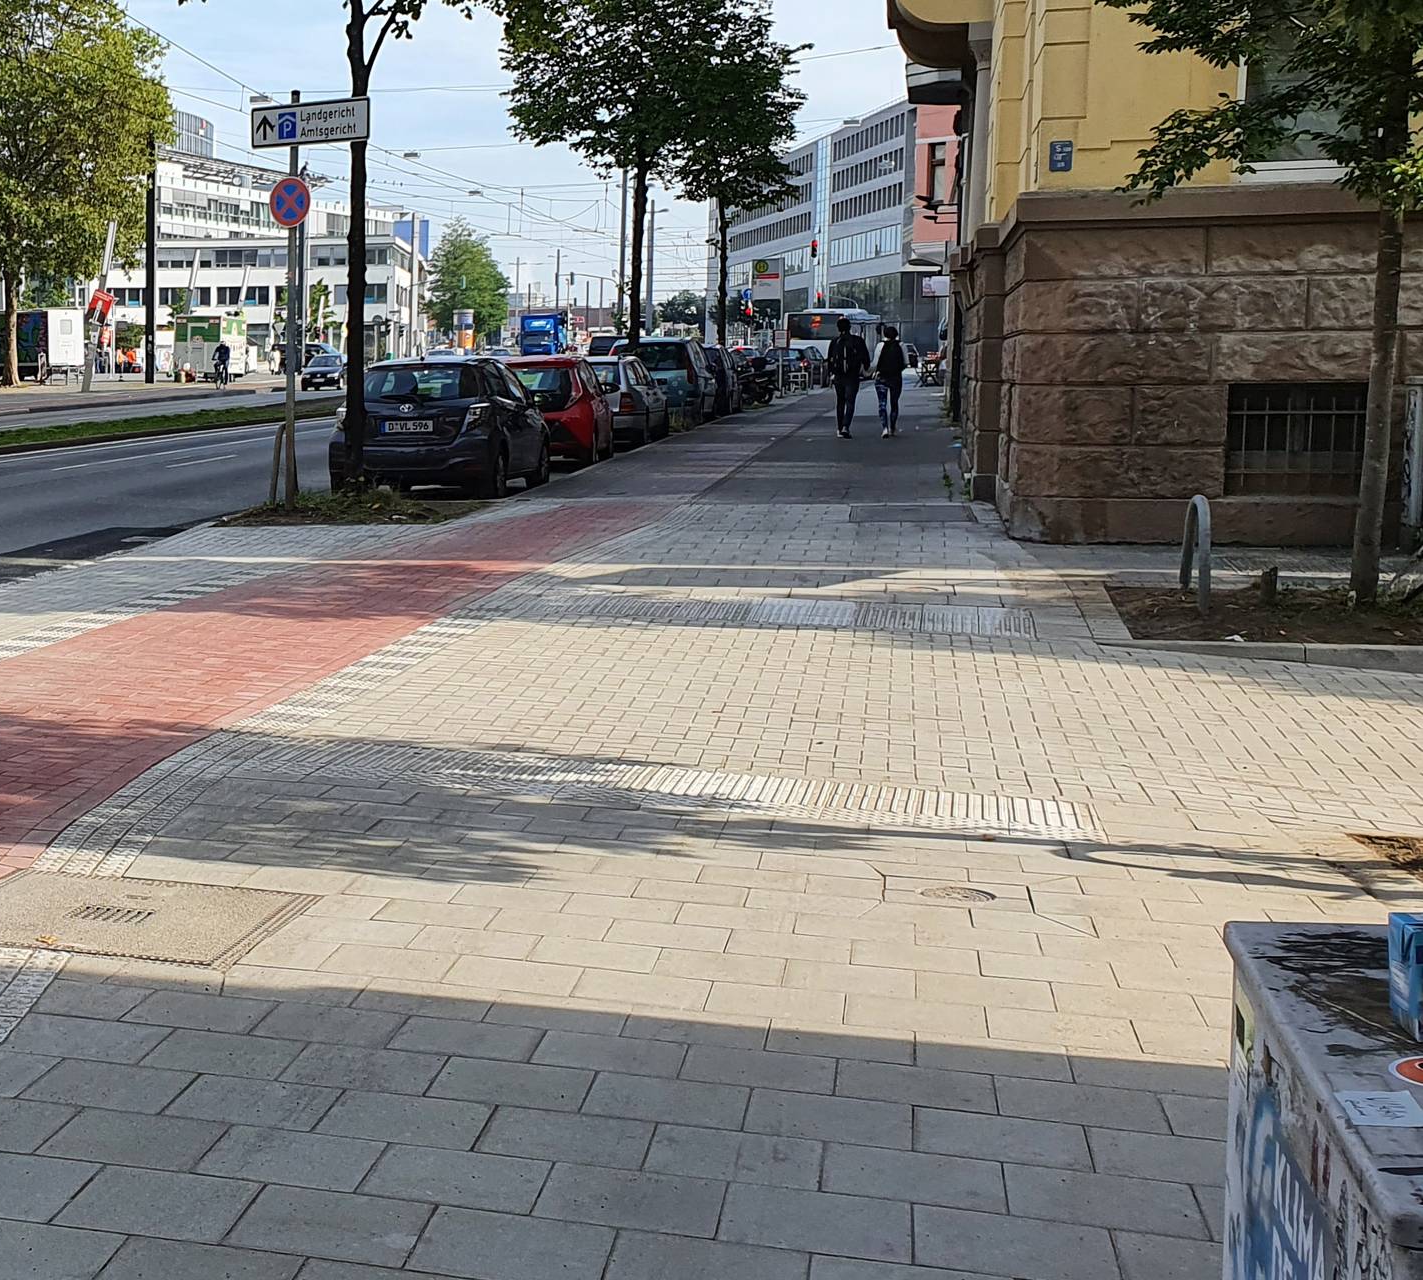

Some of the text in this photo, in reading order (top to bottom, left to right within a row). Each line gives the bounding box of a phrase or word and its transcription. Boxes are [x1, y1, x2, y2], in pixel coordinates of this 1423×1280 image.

[300, 106, 355, 121] Landgericht
[283, 120, 292, 138] P
[300, 123, 356, 138] Amtsgericht
[388, 422, 394, 431] D
[412, 422, 429, 431] 596
[1273, 1141, 1325, 1280] KLIMA
